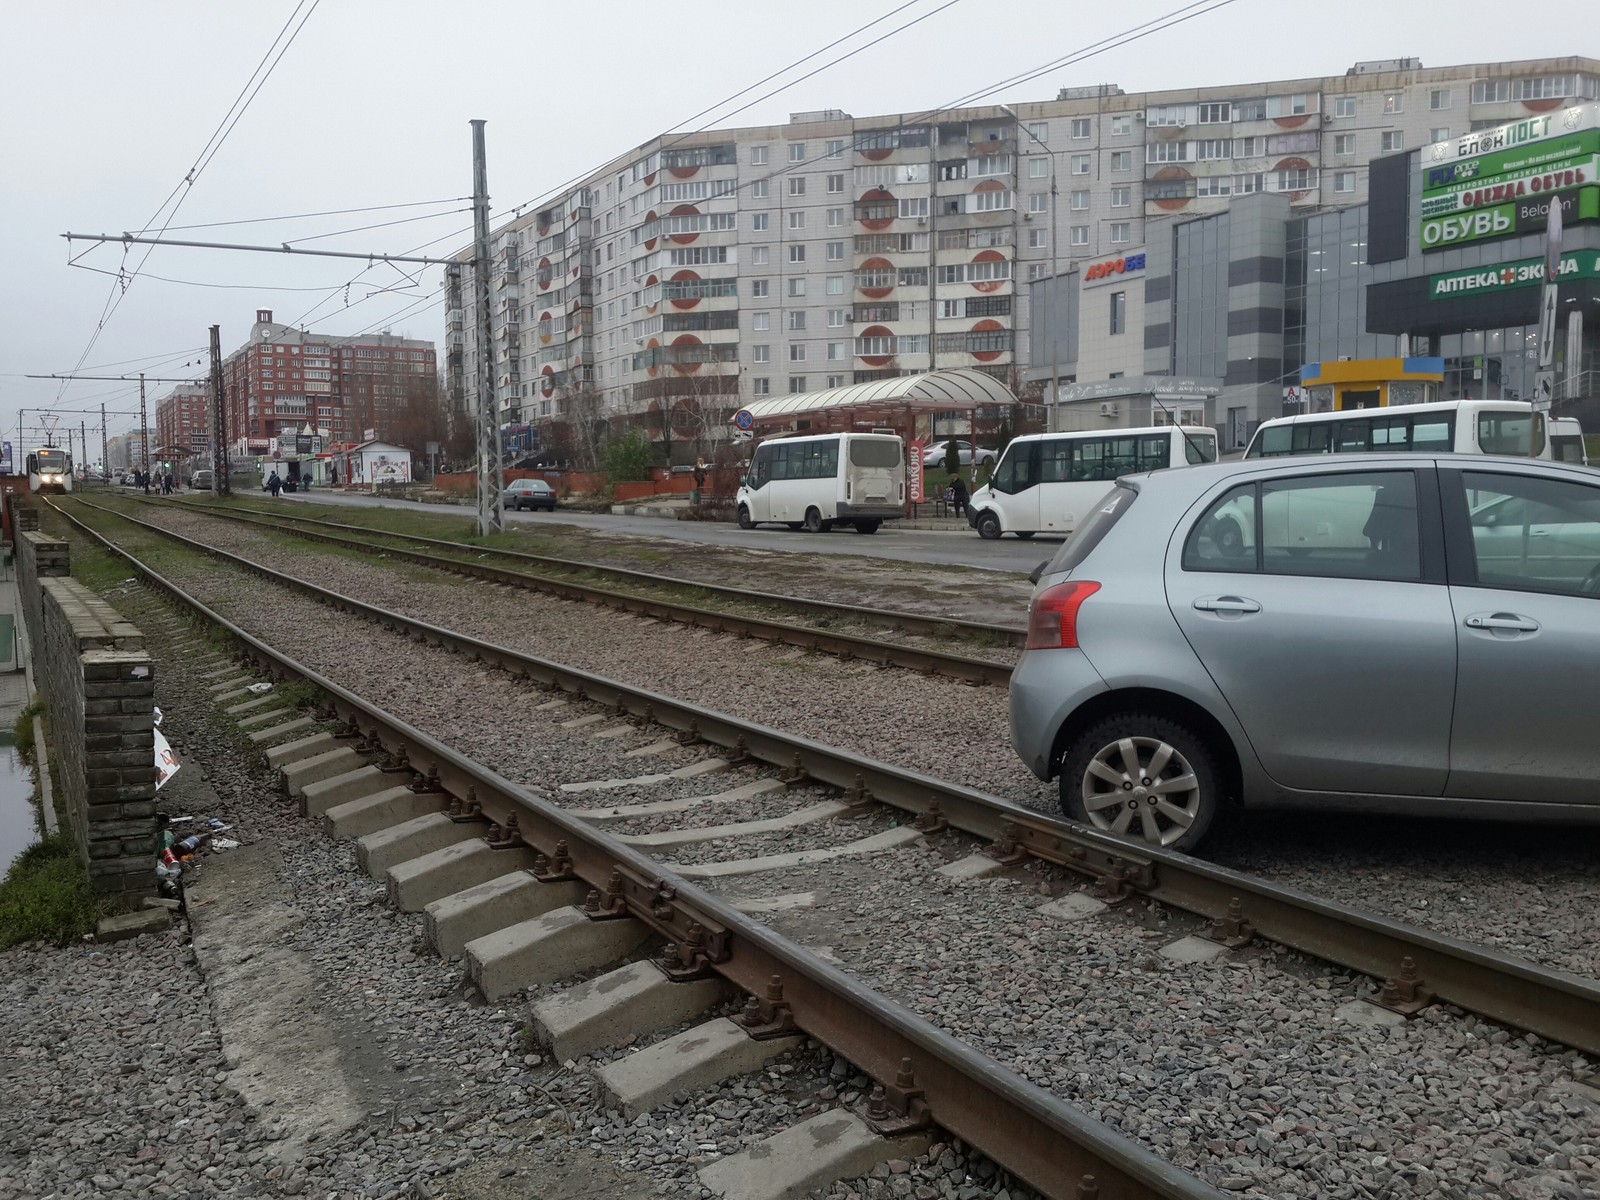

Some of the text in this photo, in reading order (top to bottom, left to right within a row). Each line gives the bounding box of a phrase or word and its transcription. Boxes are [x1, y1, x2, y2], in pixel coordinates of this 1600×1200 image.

[1447, 160, 1571, 193] НЕВЕРОЯТНО НИЗКИЕ ЦЕНЫ
[1463, 168, 1585, 206] ОДЕЖДА ОБУВЬ
[1424, 210, 1510, 244] ОБУВЬ
[1436, 271, 1499, 294] АПТЕКА
[910, 446, 920, 500] ОЧАКОВО
